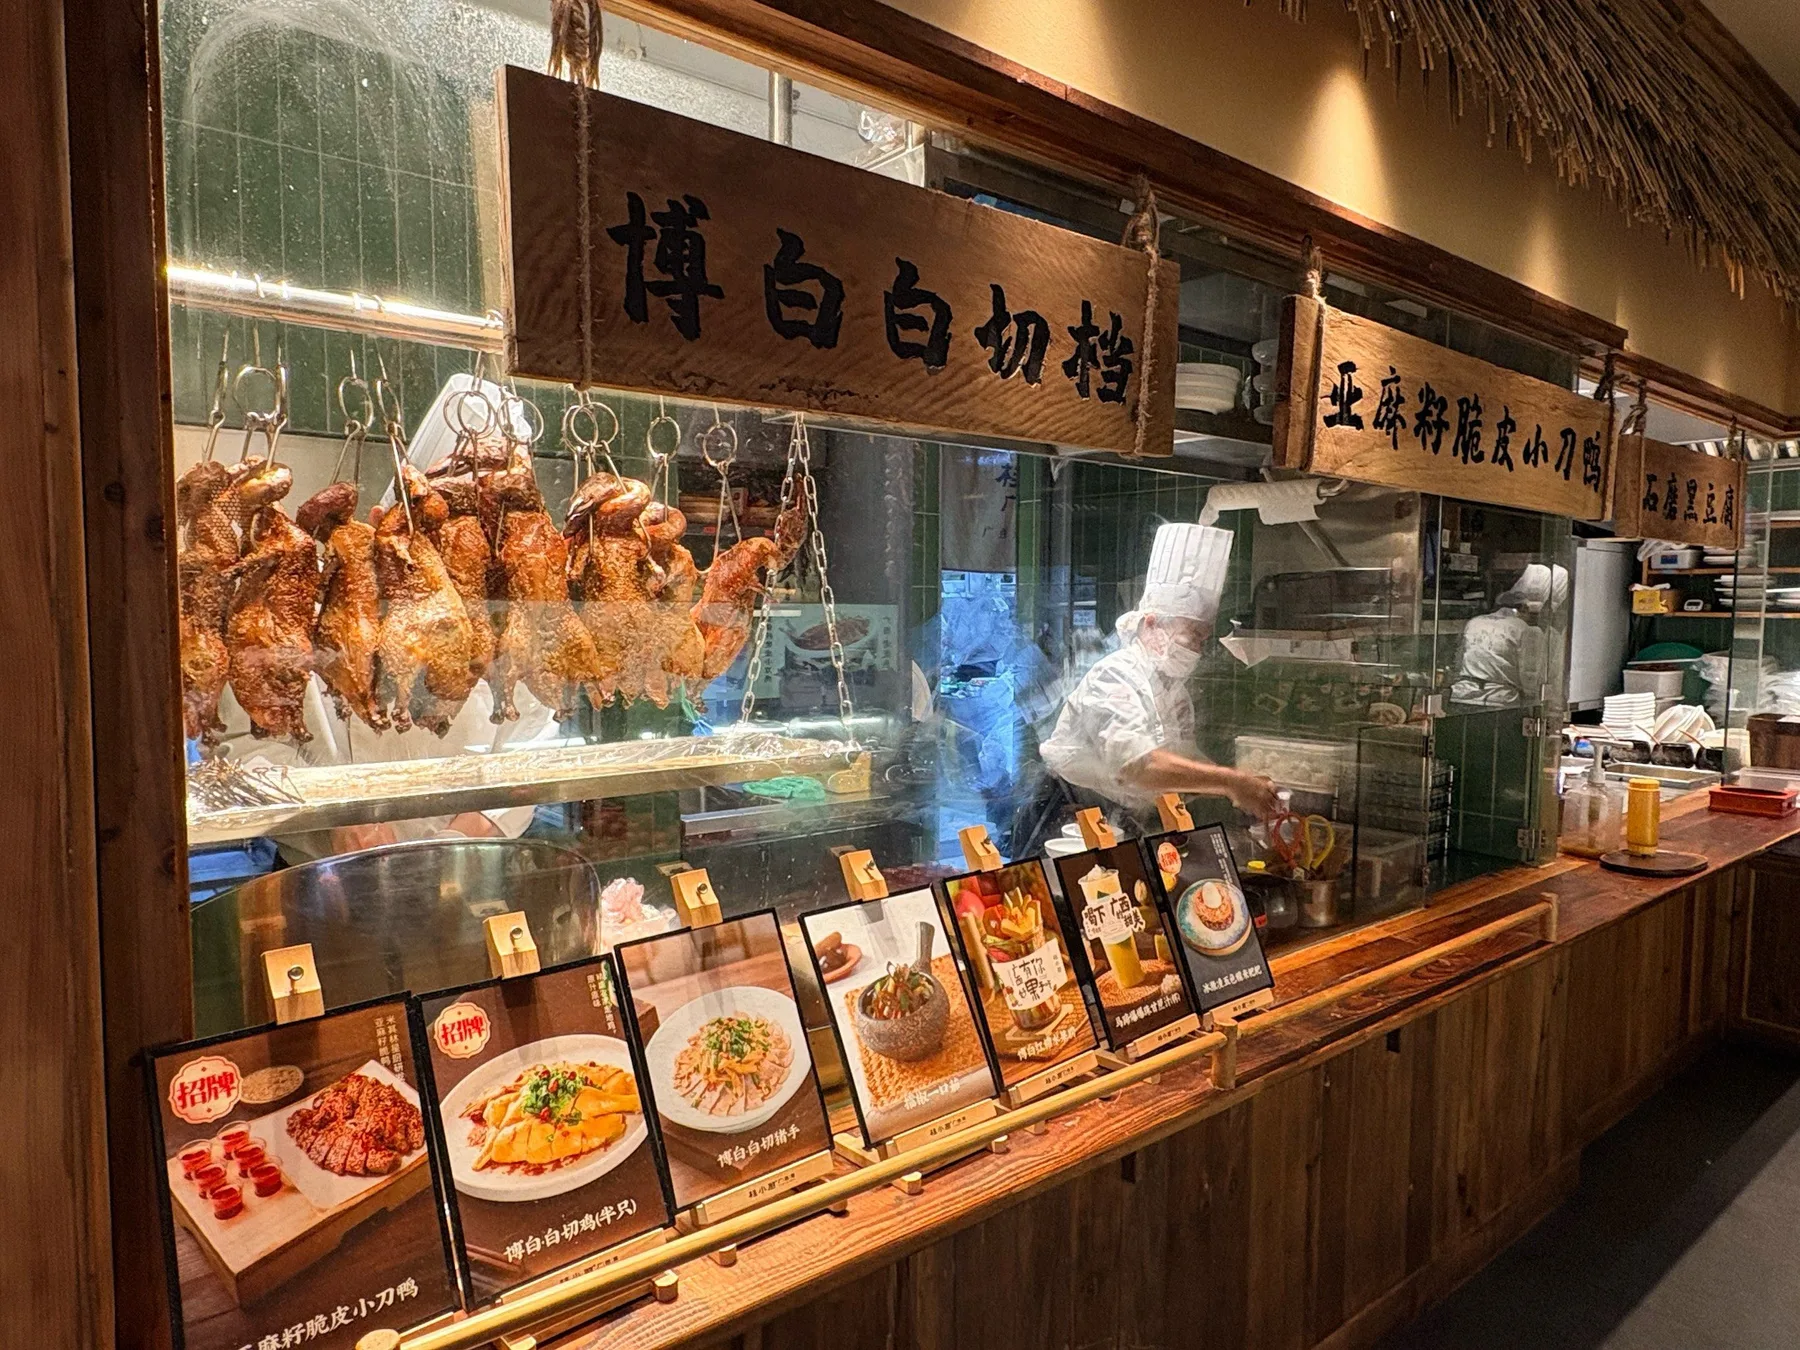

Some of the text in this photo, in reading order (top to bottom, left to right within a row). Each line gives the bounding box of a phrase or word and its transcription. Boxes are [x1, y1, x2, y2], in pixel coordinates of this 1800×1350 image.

[606, 191, 1134, 404] 博白白切档
[1321, 360, 1600, 493] 亚麻籽脆皮小刀鸭
[1642, 472, 1734, 530] 石磨黑豆腐
[441, 1016, 485, 1046] 招牌
[177, 1072, 236, 1109] 招牌
[717, 1124, 800, 1168] 博白·白切猪手
[503, 1199, 637, 1263] 博白·白切鸡(半只)
[238, 1277, 419, 1350] 麻籽脆皮小刀鸭
